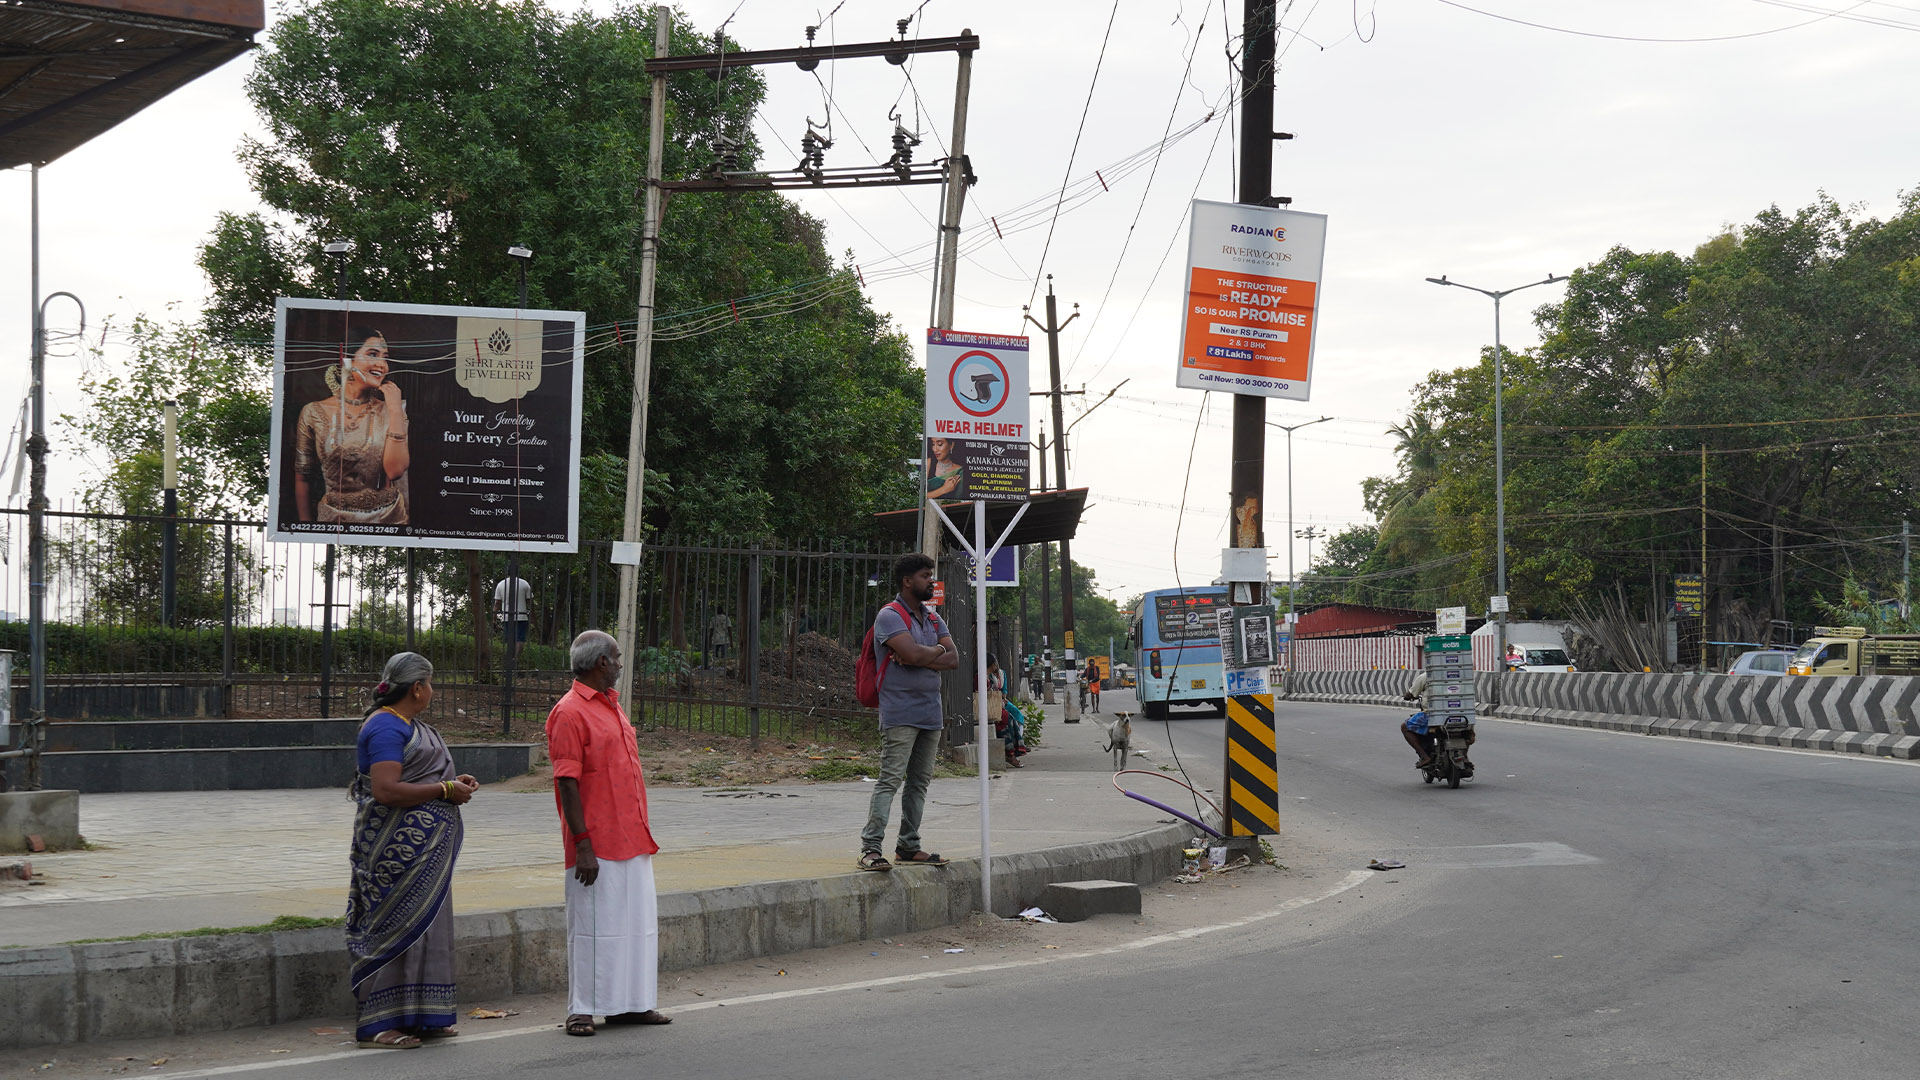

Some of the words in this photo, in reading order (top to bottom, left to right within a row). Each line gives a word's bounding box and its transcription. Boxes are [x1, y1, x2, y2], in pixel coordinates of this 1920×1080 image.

[1231, 224, 1287, 242] RADIANCE
[1222, 245, 1292, 262] RIVERWOODS
[1232, 256, 1280, 267] COIMBATORE
[1217, 278, 1234, 287] THE
[1236, 280, 1288, 294] STRUCTURE
[1219, 294, 1228, 302] IS
[1230, 290, 1281, 308] READY
[1194, 306, 1207, 314] SO
[1209, 308, 1217, 316] IS
[1218, 309, 1238, 318] OUR
[1239, 307, 1307, 327] PROMISE
[945, 333, 978, 344] COIMBATORE
[978, 335, 989, 345] CITY
[990, 336, 1009, 346] TRAFFIC
[1010, 338, 1028, 348] POLICE
[1220, 326, 1238, 335] Near
[1240, 328, 1251, 337] RS
[1252, 330, 1278, 340] Puram
[1228, 338, 1234, 346] 2
[1243, 340, 1249, 348] 3
[1250, 341, 1267, 350] BHK
[1225, 348, 1252, 360] Lakhs
[1255, 353, 1287, 363] onwards
[465, 358, 493, 368] SHRI
[497, 359, 533, 370] ARTHI
[463, 369, 533, 381] JEWELLERY
[1198, 373, 1214, 382] Call
[1214, 375, 1234, 384] Now:
[1235, 377, 1251, 386] 900
[1251, 379, 1273, 389] 3000
[1273, 381, 1289, 390] 700
[453, 410, 484, 424] Your
[486, 410, 536, 431] Jewellery
[935, 419, 971, 434] WEAR
[974, 422, 1023, 437] HELMET
[443, 431, 462, 443] for
[466, 431, 503, 447] Every
[506, 431, 548, 446] Emotion
[443, 475, 464, 483] Gold
[472, 476, 511, 485] Diamond
[519, 478, 545, 487] Silver
[469, 507, 513, 516] Since-1998
[290, 523, 311, 531] 0422
[311, 523, 326, 531] 223
[349, 525, 374, 533] 90258
[375, 526, 399, 534] 27487
[466, 530, 507, 538] Gandhipuram,
[971, 566, 992, 577] 32
[1187, 613, 1198, 624] 2
[1226, 671, 1245, 691] PF
